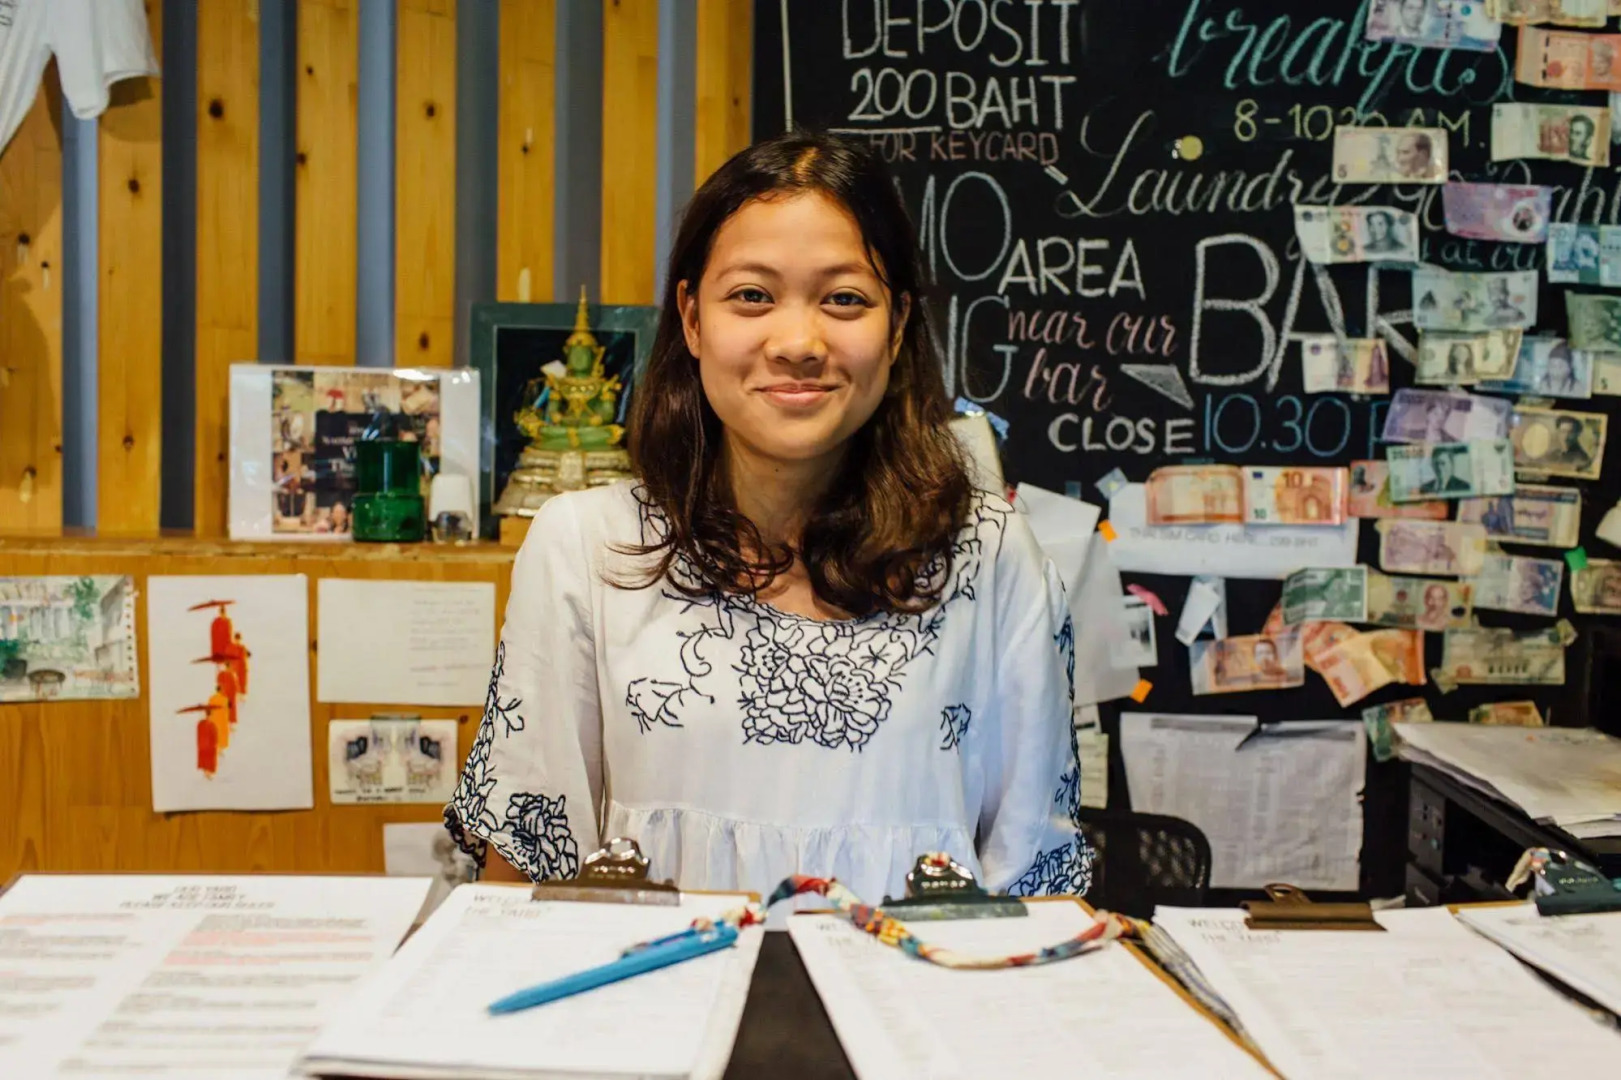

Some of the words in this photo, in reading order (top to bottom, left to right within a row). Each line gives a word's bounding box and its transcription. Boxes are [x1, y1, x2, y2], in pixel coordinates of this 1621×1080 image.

[842, 0, 1080, 67] DEPOSIT
[848, 67, 938, 121] 200
[945, 71, 1077, 130] BAHT
[929, 130, 1060, 166] KEYCARD
[997, 237, 1146, 301] AREA
[1007, 308, 1096, 349] near
[1105, 311, 1179, 356] our
[1188, 233, 1419, 394] BAR
[1023, 347, 1113, 412] bar
[1047, 413, 1196, 454] CLOSE
[1204, 393, 1352, 458] 10.30
